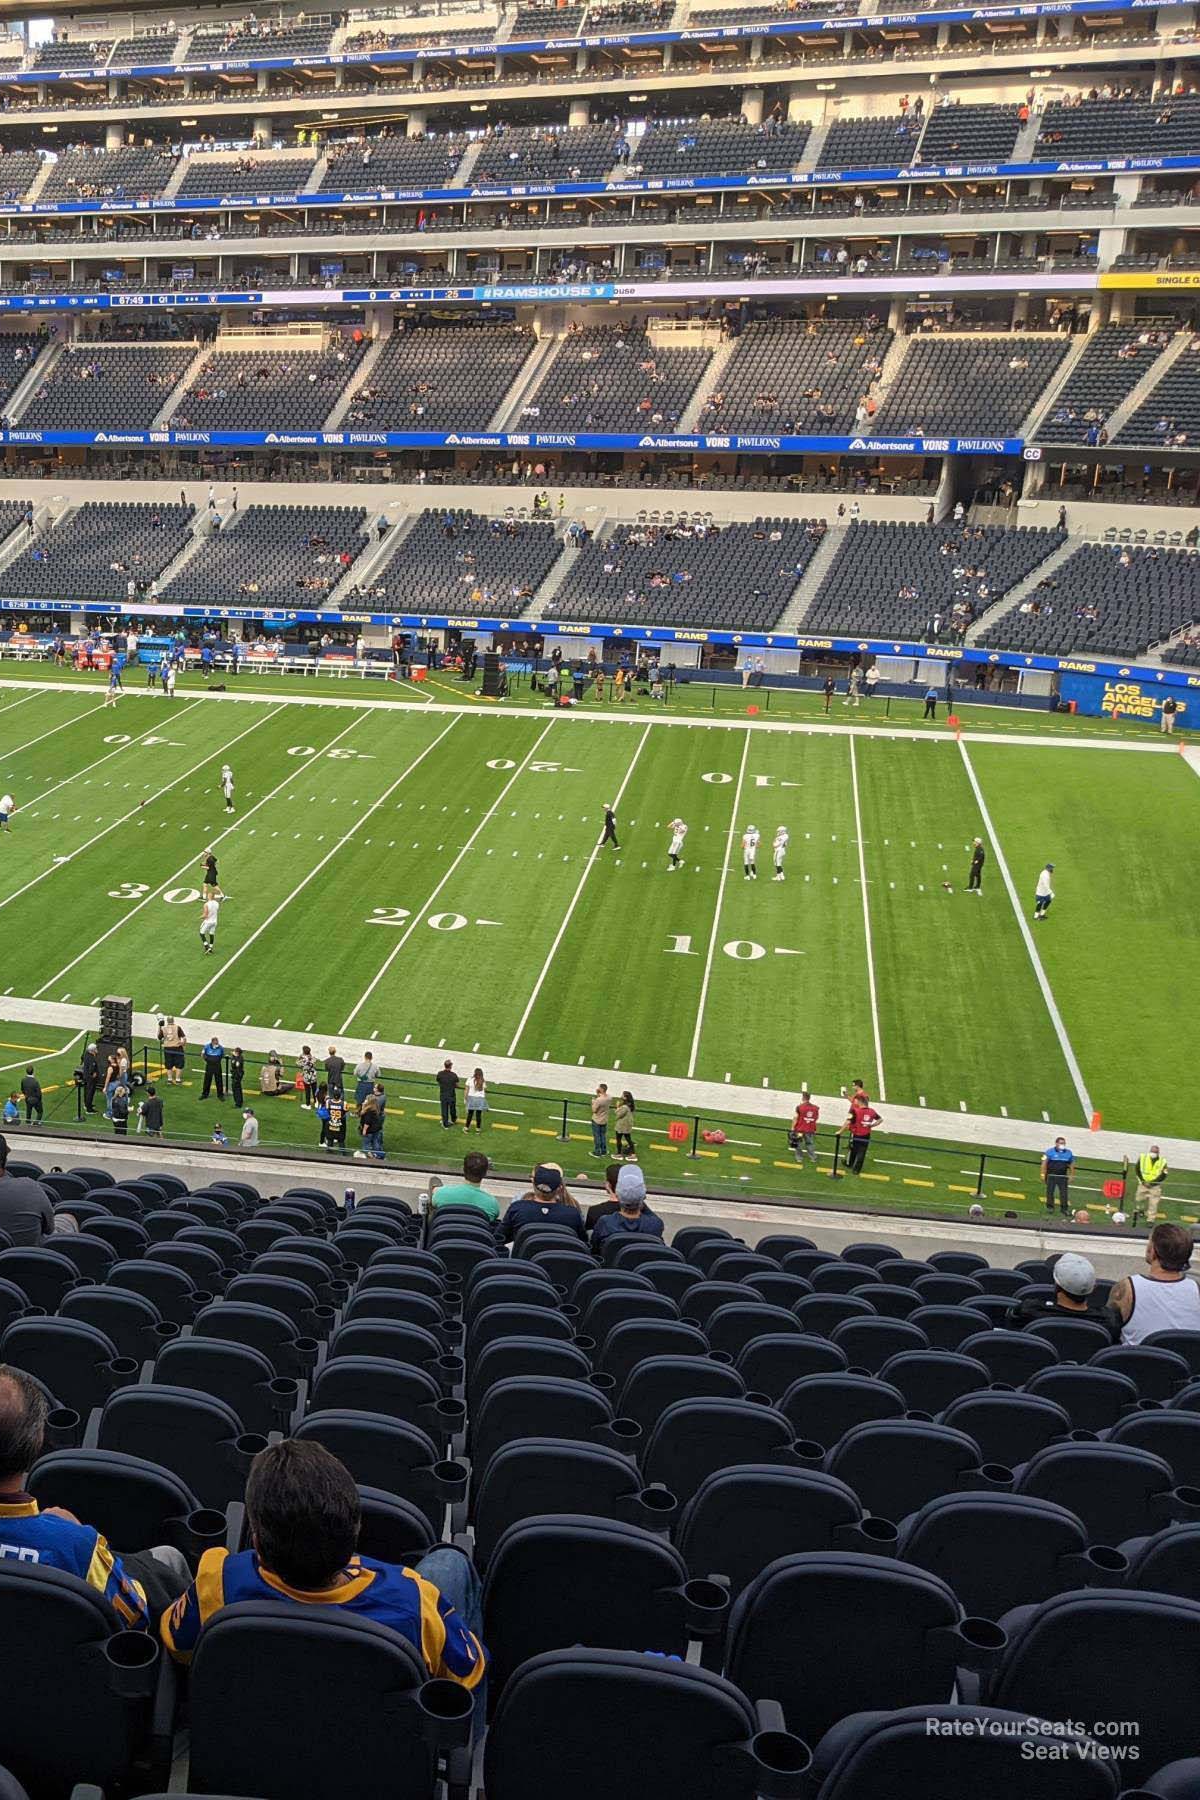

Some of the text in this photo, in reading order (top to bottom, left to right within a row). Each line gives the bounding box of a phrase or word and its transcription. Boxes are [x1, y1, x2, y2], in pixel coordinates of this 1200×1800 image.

[484, 287, 590, 298] #RAMSHOUSE
[119, 296, 143, 304] 67:49
[8, 432, 42, 441] PAVILIONS
[108, 432, 210, 442] Albertsons VONS PAVILIONS
[279, 433, 387, 443] Albertsons VONS PAVILIONS
[460, 434, 576, 445] Albertsons VONS PAVILIONS
[656, 437, 780, 448] Albertsons VONS PAVILIONS
[866, 439, 1004, 452] Albertsons VONS PAVILIONS
[1025, 450, 1039, 458] CC
[342, 615, 371, 623] RAMS
[448, 620, 478, 628] RAMS
[559, 625, 590, 634] RAMS
[674, 632, 707, 640] RAMS
[797, 639, 832, 648] RAMS
[926, 648, 963, 657] RAMS
[1058, 661, 1096, 672] RAMS
[1105, 682, 1140, 695] LOS
[1103, 693, 1186, 712] ANGELS
[1102, 702, 1153, 717] RAMS
[107, 882, 200, 906] 30
[364, 907, 468, 931] 20
[664, 935, 766, 960] 10
